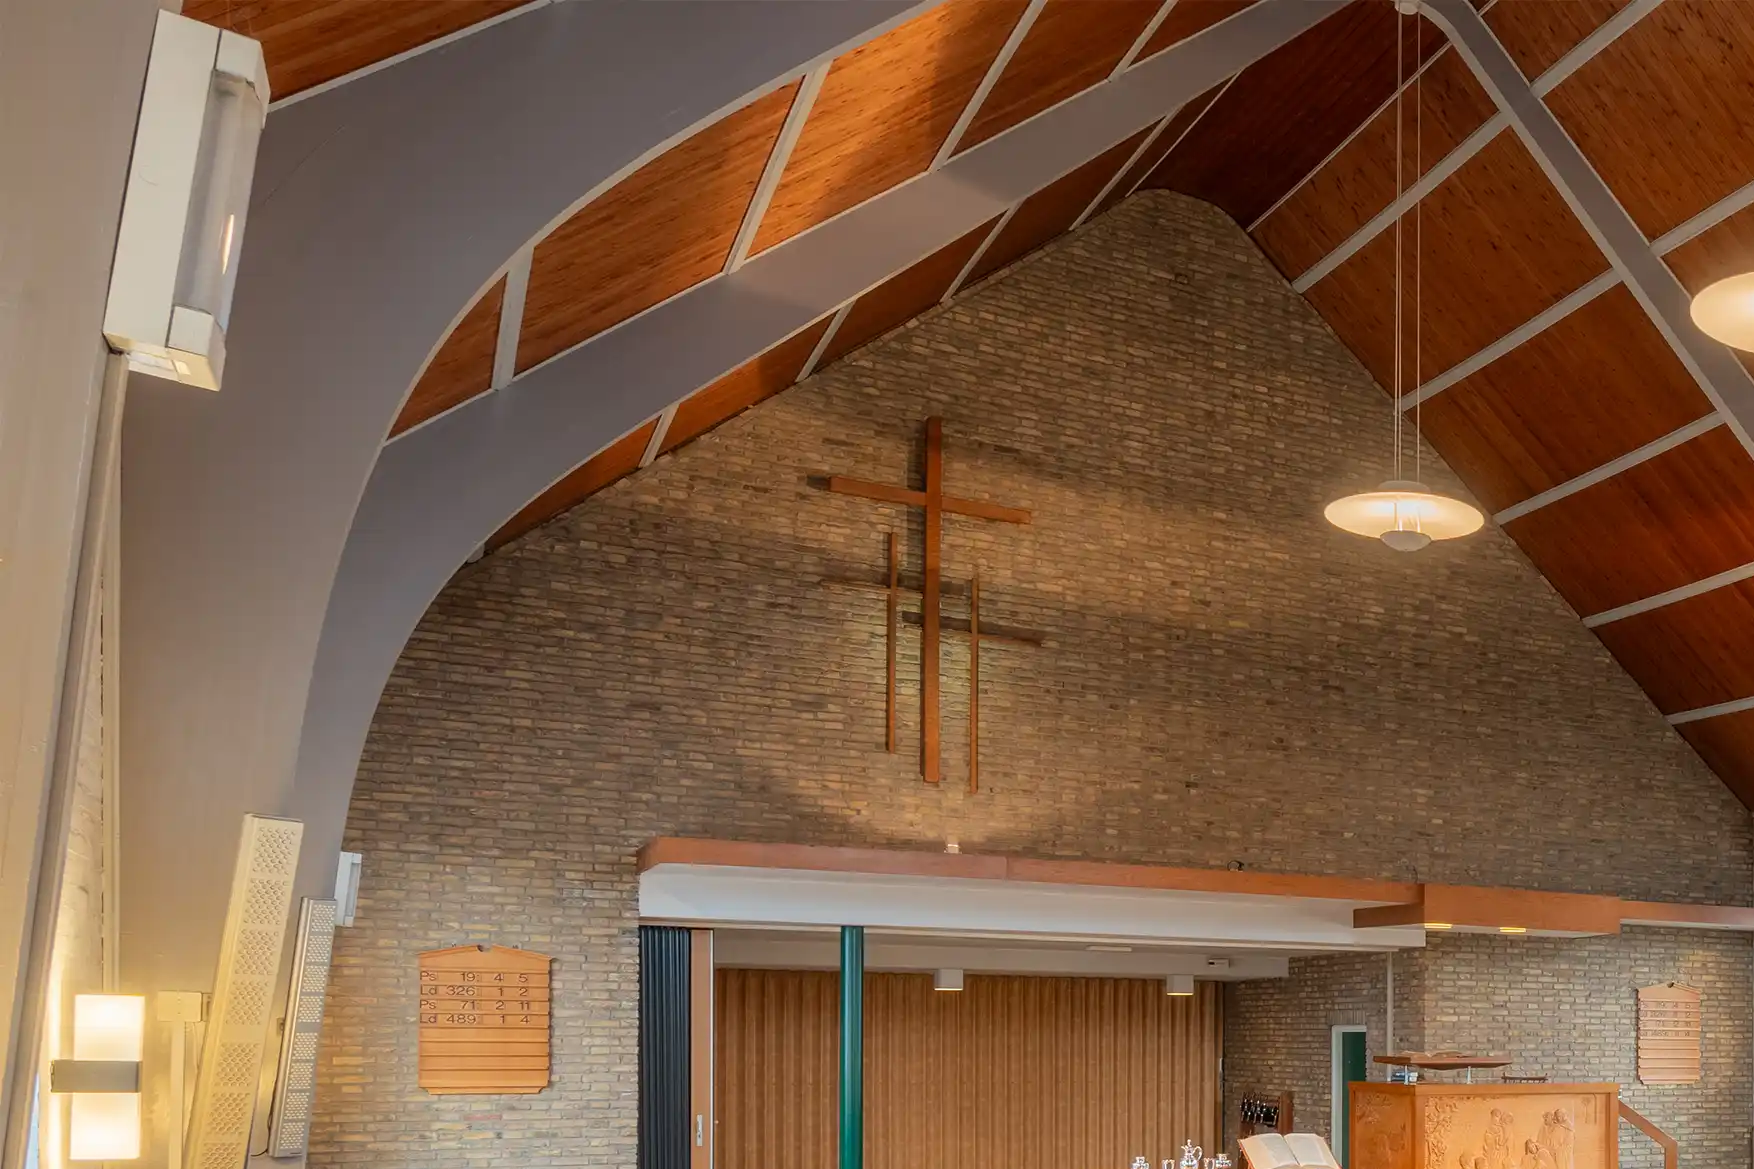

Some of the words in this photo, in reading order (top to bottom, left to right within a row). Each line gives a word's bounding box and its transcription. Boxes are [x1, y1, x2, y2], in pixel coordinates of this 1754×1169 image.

[419, 970, 437, 981] Ps
[493, 973, 504, 982] 4
[518, 973, 528, 983] 5
[419, 985, 437, 996] Ld
[519, 987, 528, 997] 2
[419, 999, 437, 1010] Ps
[495, 1001, 505, 1010] 2
[518, 1002, 530, 1010] 11
[419, 1013, 437, 1024] Ld
[520, 1015, 530, 1024] 4
